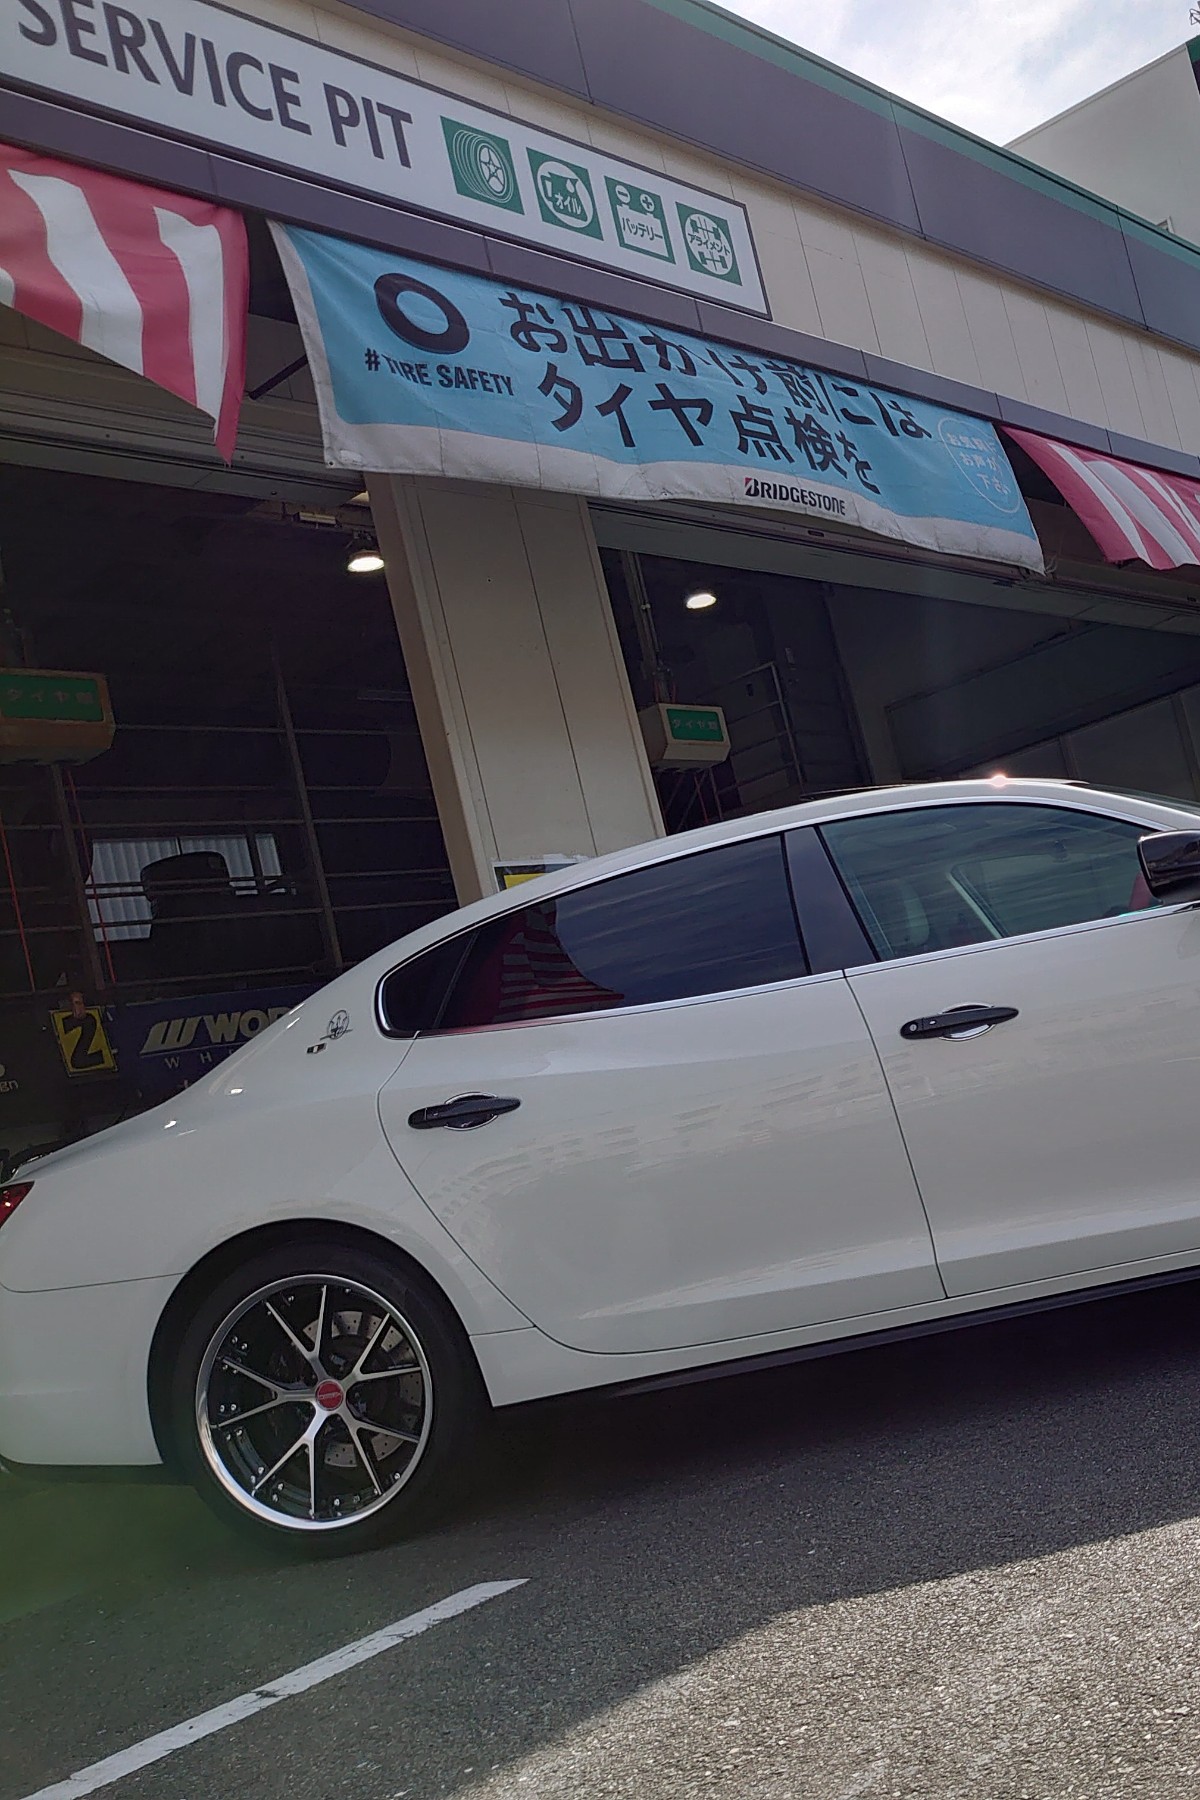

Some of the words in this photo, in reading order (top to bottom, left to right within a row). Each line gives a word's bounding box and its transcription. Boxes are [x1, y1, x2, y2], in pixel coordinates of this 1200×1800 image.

[18, 0, 313, 136] SERVICE
[322, 82, 414, 169] PIT
[553, 192, 582, 216] オイル
[622, 217, 663, 242] バッテリー
[687, 232, 731, 257] アライメント
[438, 363, 515, 397] SAFETY
[498, 291, 933, 440] お出かけ前には
[537, 361, 882, 495] タイヤ点検を
[744, 477, 846, 516] BRIDGESTONE
[63, 1013, 105, 1069] 2
